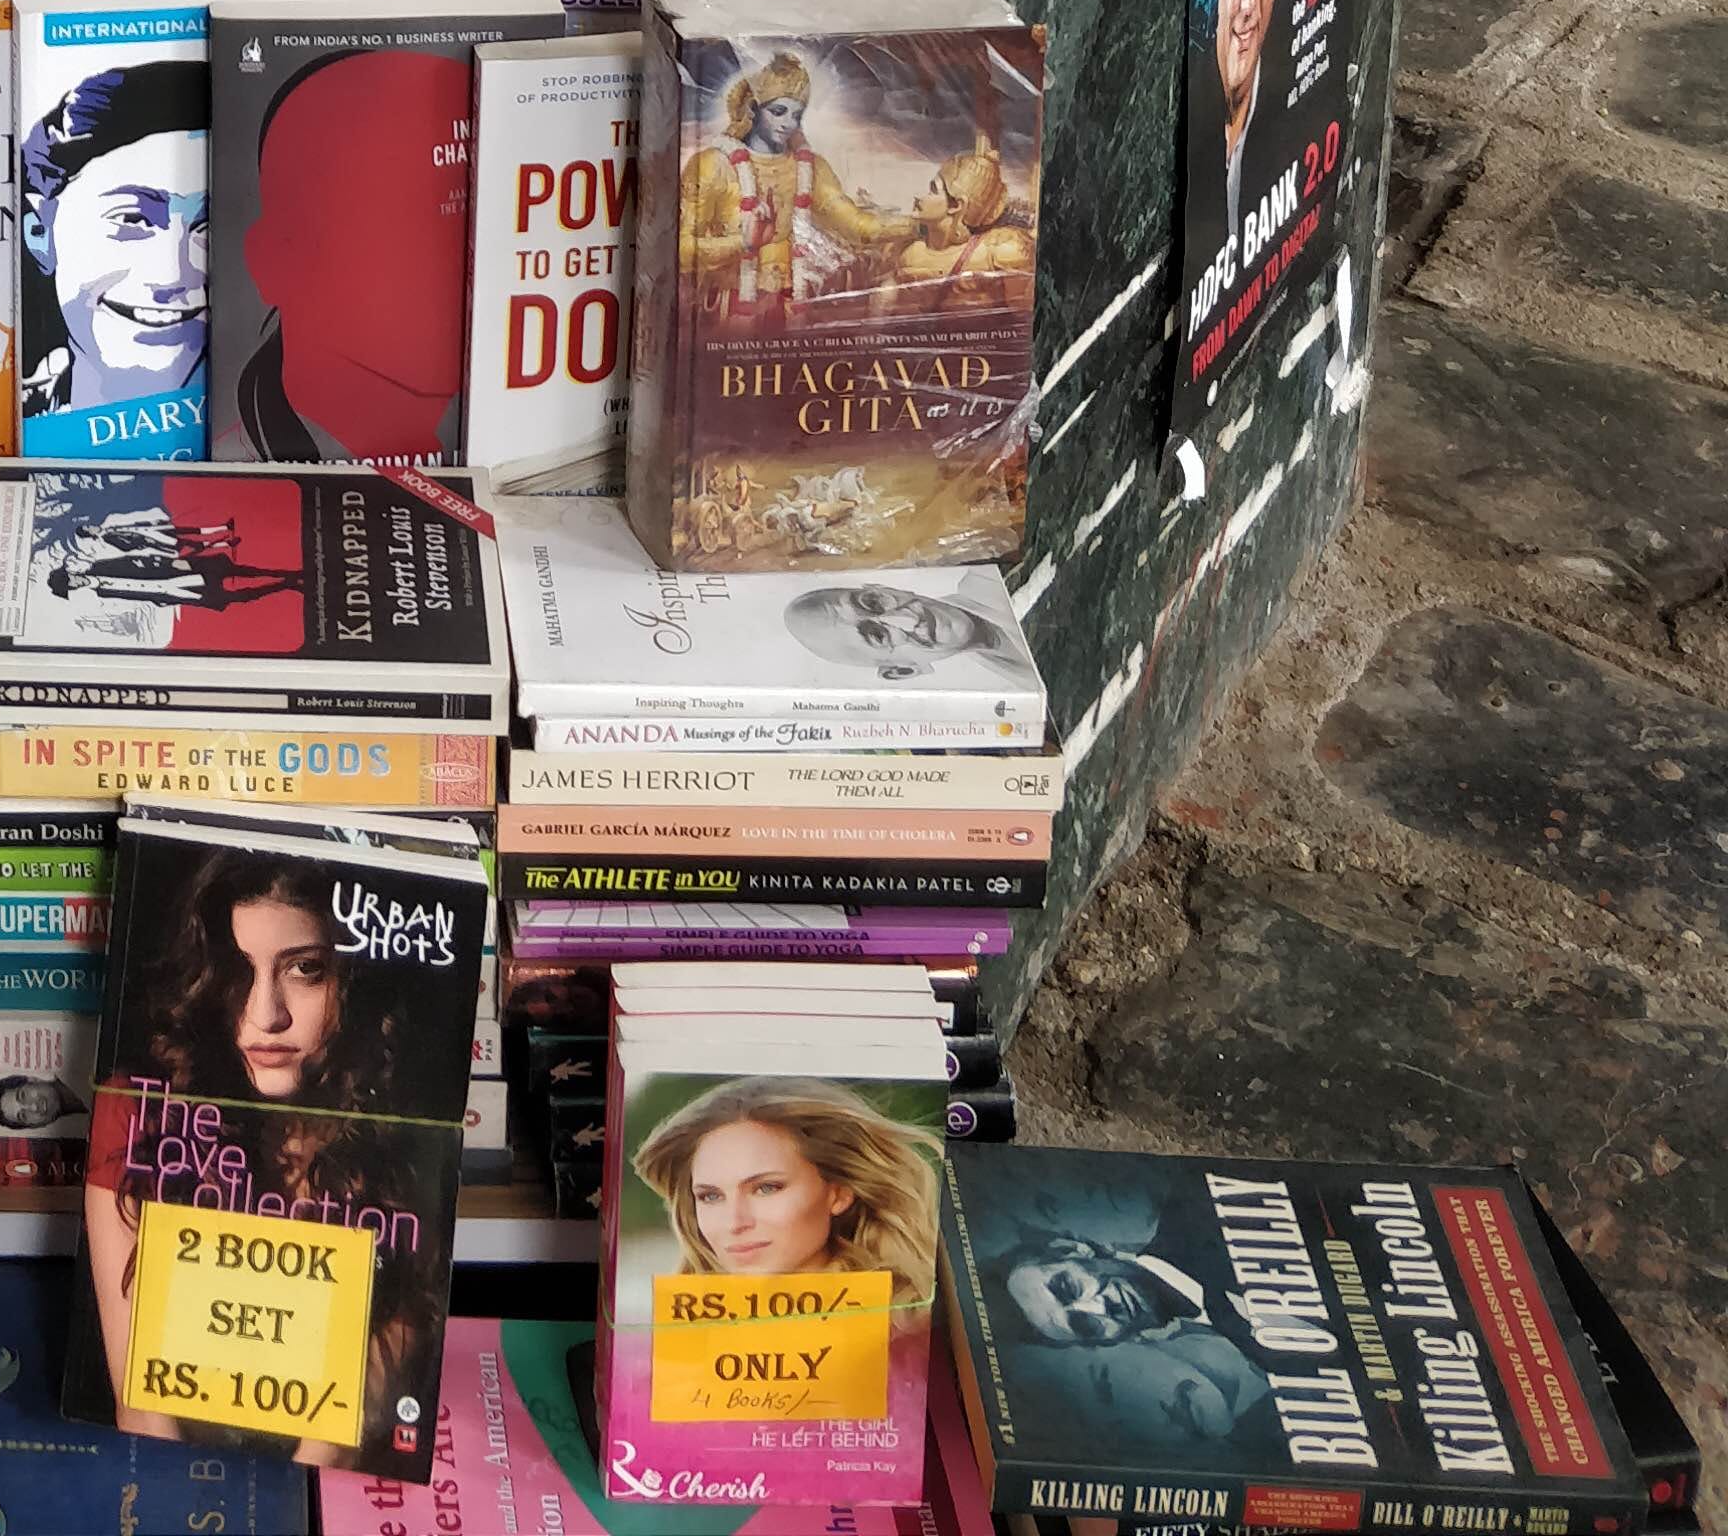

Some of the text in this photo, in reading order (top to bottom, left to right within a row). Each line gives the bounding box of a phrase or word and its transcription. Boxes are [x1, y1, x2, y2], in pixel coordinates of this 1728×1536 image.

[274, 34, 310, 46] FROM
[314, 33, 359, 45] INDIA'S
[387, 33, 392, 44] 1
[396, 32, 456, 45] BUSINESS
[459, 30, 504, 43] WRITER
[1187, 120, 1341, 341] HDFC BANK 2.0
[721, 356, 991, 399] BHAGAVAD
[337, 489, 373, 644] KIDNAPPED
[383, 505, 421, 627] Robert Louis
[424, 522, 454, 612] Stevenson
[97, 772, 295, 793] EDWARD LUCE
[522, 770, 755, 791] JAMES HERRIOT
[41, 821, 104, 842] Doshi
[176, 1227, 338, 1285] 2 BOOK
[209, 1300, 295, 1346] SET
[671, 1287, 863, 1322] RS.100/-
[1350, 1180, 1514, 1475] Killing Lincoln
[715, 1347, 833, 1381] ONLY
[142, 1358, 350, 1421] RS. 100/-
[669, 1472, 770, 1499] Cherish
[826, 1460, 897, 1474] Patricia Kay
[1031, 1479, 1229, 1517] KILLING LINCOLN
[1372, 1500, 1510, 1530] BILL O'REILLY
